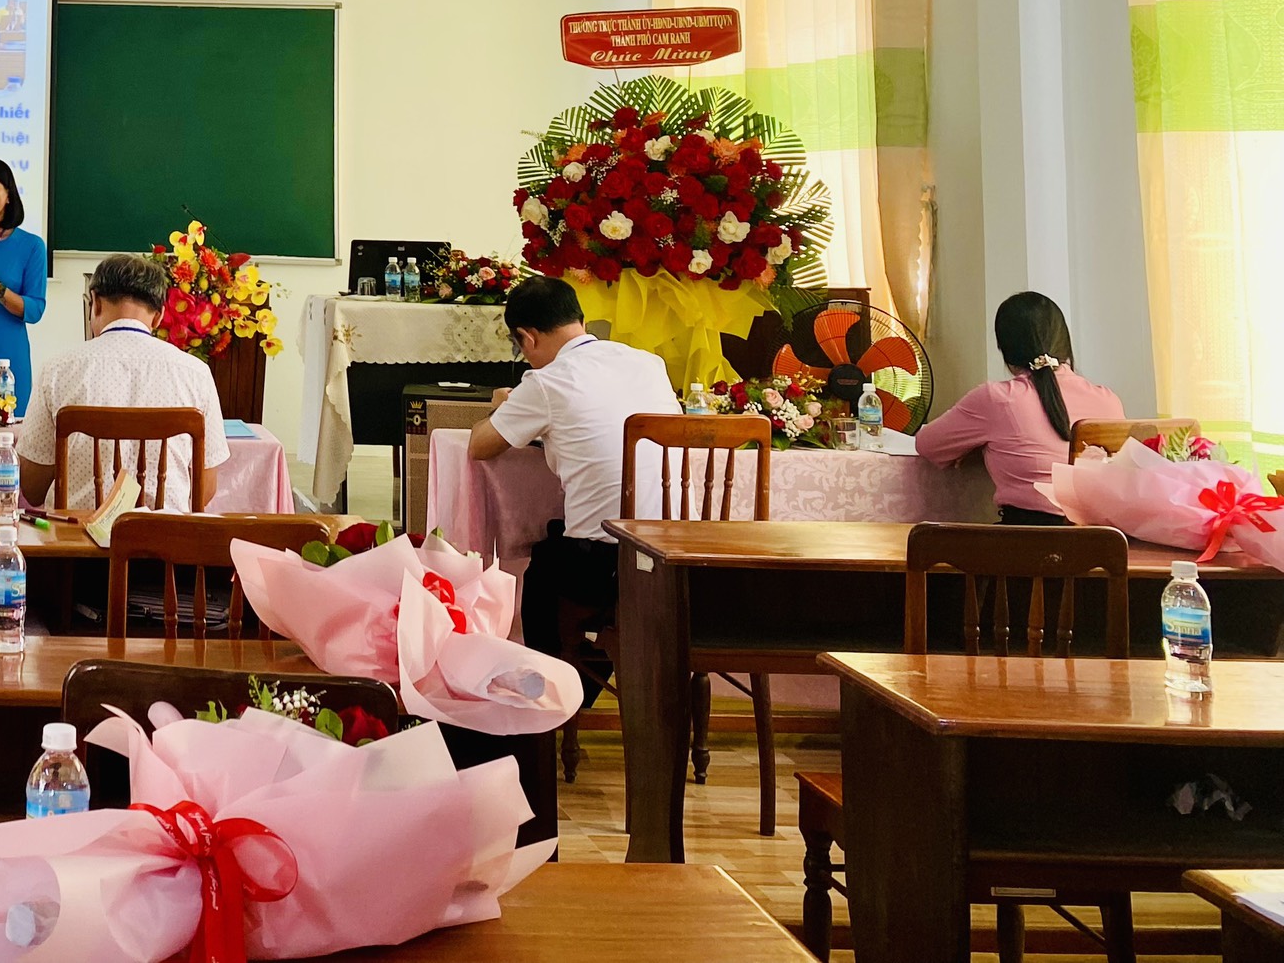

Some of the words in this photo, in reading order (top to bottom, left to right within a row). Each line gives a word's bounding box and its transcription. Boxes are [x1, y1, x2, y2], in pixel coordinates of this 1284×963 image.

[568, 18, 598, 34] THƯỜNG
[598, 18, 617, 35] TRỰC
[618, 16, 641, 31] THÀNH
[610, 31, 636, 47] THÀNH
[636, 30, 652, 46] PHỐ
[652, 32, 669, 45] CAM
[670, 31, 691, 45] RANH
[590, 50, 642, 63] Chúc
[647, 48, 713, 61] Mừng
[1, 131, 29, 146] biệt
